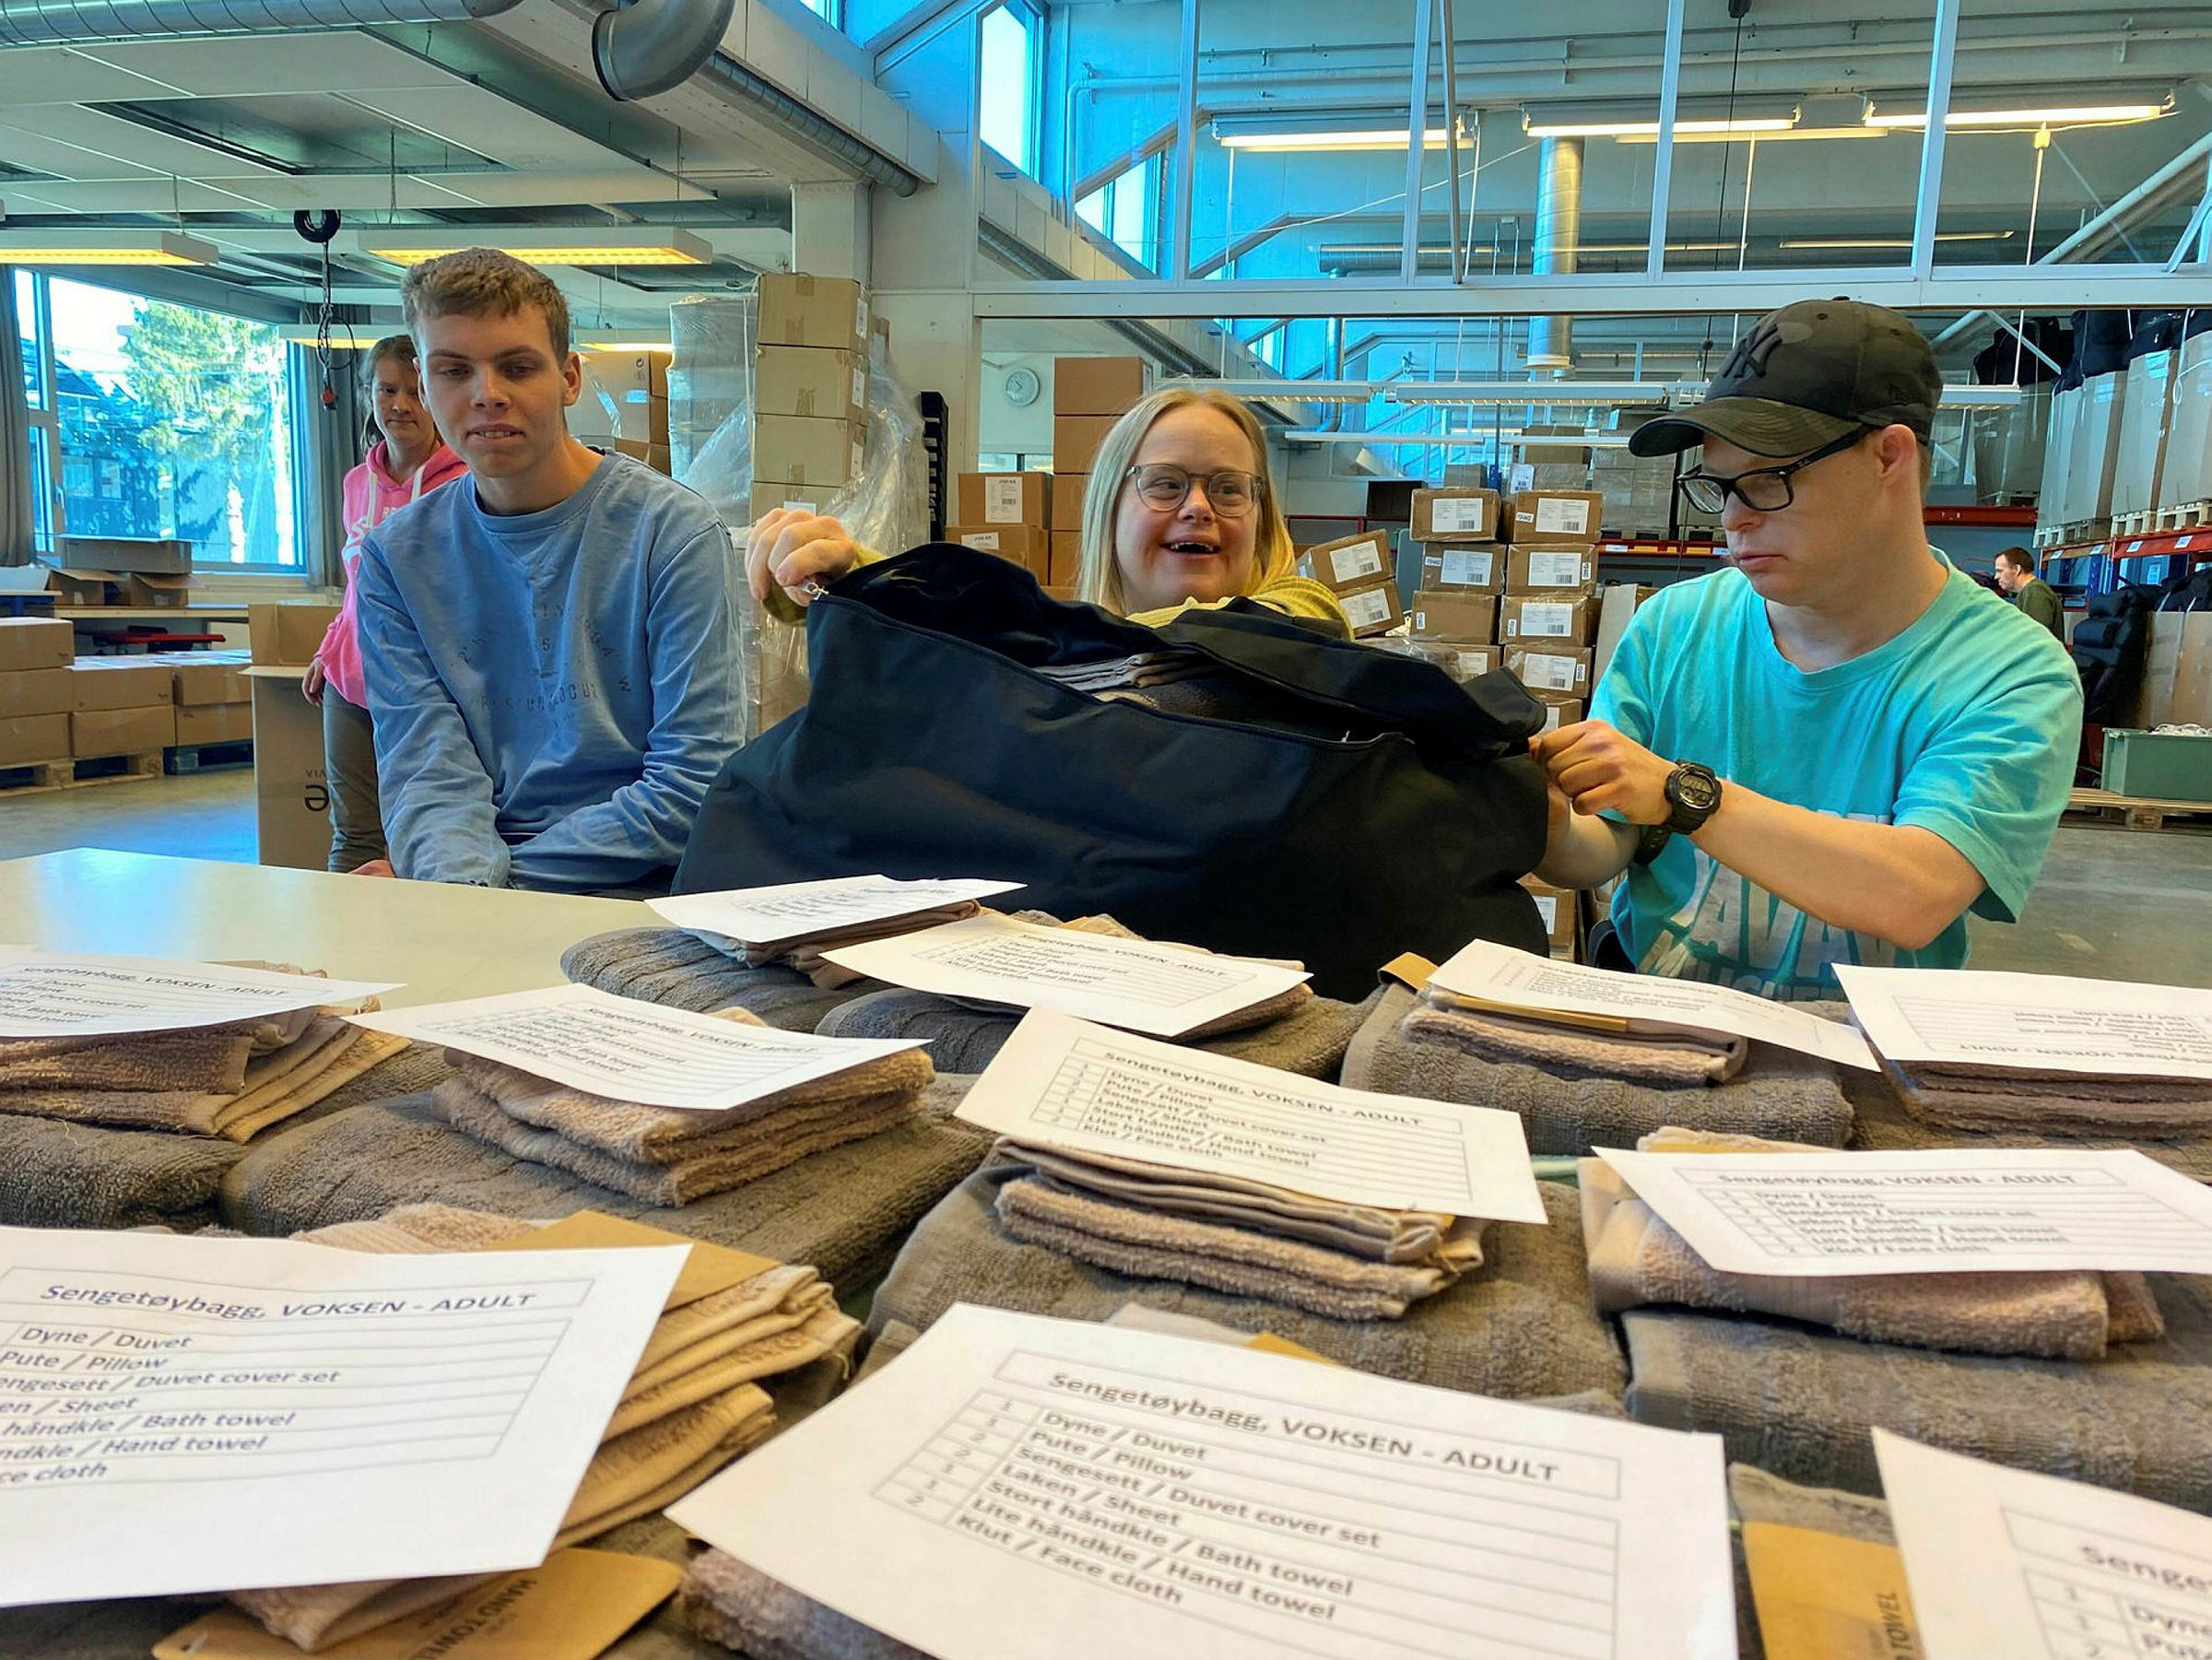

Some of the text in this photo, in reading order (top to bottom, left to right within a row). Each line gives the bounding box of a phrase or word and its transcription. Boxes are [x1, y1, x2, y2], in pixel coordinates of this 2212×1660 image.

[1107, 1080, 1142, 1093] Pute
[1159, 1094, 1207, 1110] Pillow
[1112, 1072, 1150, 1086] Dyne
[1168, 1087, 1213, 1102] Duvet
[1099, 1097, 1144, 1113] Laken
[1162, 1113, 1207, 1127] Sheet
[1103, 1089, 1179, 1112] Sengesett
[1197, 1112, 1245, 1126] Duvet
[1252, 1124, 1296, 1136] cover
[1301, 1135, 1325, 1143] set
[1253, 1089, 1333, 1113] VOKSEN
[1353, 1110, 1422, 1124] ADULT
[1088, 1115, 1118, 1127] Lite
[1210, 1142, 1254, 1155] Hand
[1259, 1151, 1309, 1166] towel
[1092, 1107, 1132, 1121] Stort
[1223, 1135, 1263, 1148] Bath
[1267, 1143, 1316, 1159] towel
[1135, 1135, 1174, 1148] Face
[1179, 1144, 1222, 1159] cloth
[1884, 1175, 1981, 1184] VOKSEN
[2001, 1175, 2076, 1184] ADULT
[40, 1285, 266, 1320] Sengetøybagg,
[282, 1301, 406, 1316] VOKSEN
[430, 1293, 537, 1311] ADULT
[20, 1327, 88, 1345] Dyne
[114, 1333, 192, 1349] Duvet
[0, 1351, 60, 1369] Pute
[87, 1355, 169, 1371] Pillow
[134, 1372, 216, 1388] Duvet
[220, 1372, 296, 1384] cover
[297, 1370, 341, 1383] set
[58, 1397, 138, 1414] Sheet
[2, 1419, 115, 1435] håndkle
[142, 1413, 207, 1429] Bath
[215, 1412, 297, 1427] towel
[1042, 1411, 1109, 1437] Dyne
[1130, 1432, 1209, 1460] Duvet
[1049, 1372, 1269, 1433] Sengetøybagg,
[1281, 1418, 1413, 1456] VOKSEN
[1441, 1449, 1560, 1482] ADULT
[102, 1437, 182, 1454] Hand
[184, 1436, 268, 1451] towel
[1030, 1430, 1088, 1455] Pute
[1112, 1452, 1194, 1480] Pillow
[34, 1463, 110, 1482] cloth
[1002, 1463, 1078, 1496] Laken
[1102, 1492, 1182, 1527] Sheet
[1016, 1445, 1144, 1492] Sengesett
[1168, 1487, 1249, 1521] Duvet
[1254, 1510, 1332, 1538] cover
[1338, 1528, 1382, 1549] set
[985, 1478, 1053, 1512] Stort
[1058, 1502, 1171, 1548] håndkle
[1196, 1543, 1264, 1572] Bath
[1269, 1562, 1354, 1597] towel
[957, 1514, 1014, 1546] Klut
[1039, 1547, 1106, 1578] Face
[1109, 1571, 1183, 1604] cloth
[971, 1496, 1021, 1525] Lite
[1026, 1516, 1139, 1564] håndkle
[1166, 1561, 1245, 1595] Hand
[1251, 1586, 1336, 1621] towel
[478, 1578, 537, 1617] HAND
[1876, 1591, 1912, 1650] TOWEL
